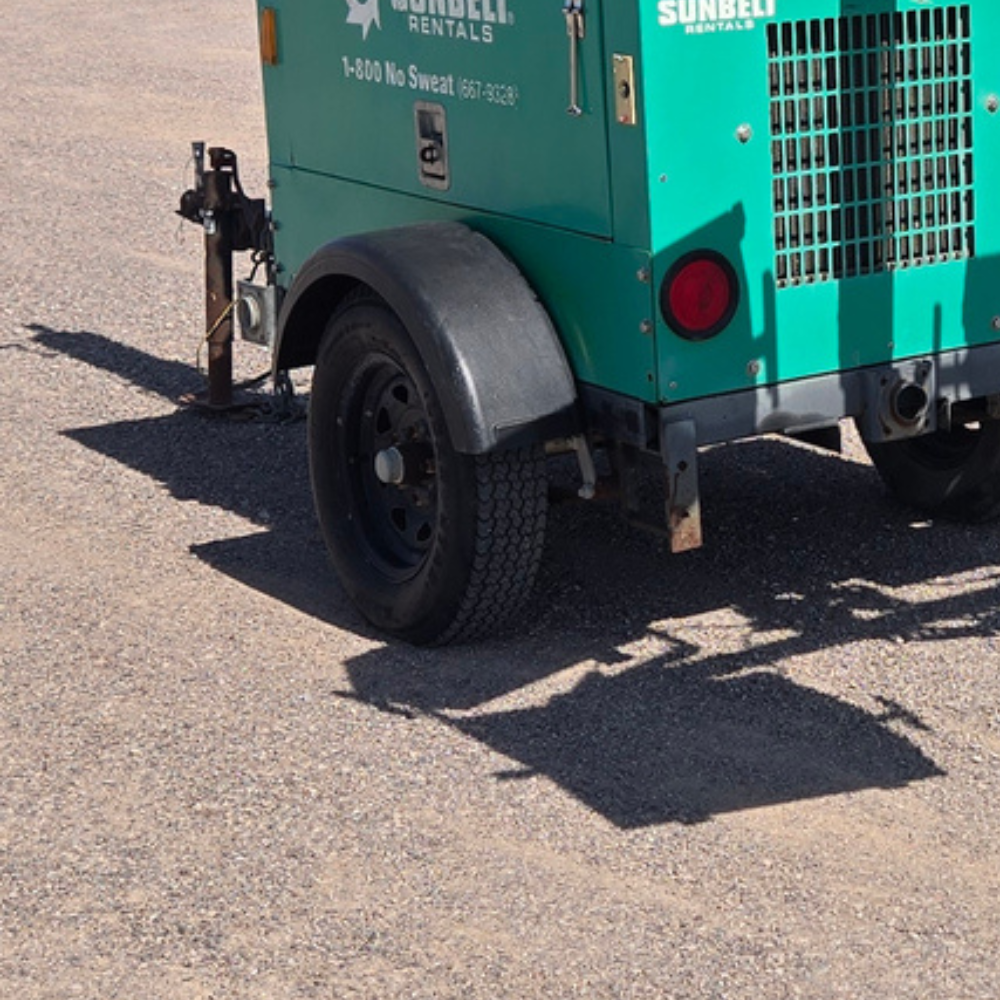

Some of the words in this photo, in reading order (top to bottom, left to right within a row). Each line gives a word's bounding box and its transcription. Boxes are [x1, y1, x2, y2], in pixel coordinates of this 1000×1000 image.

[408, 15, 493, 43] RENTALS
[685, 19, 755, 35] RENTALS
[341, 55, 382, 83] 1-800
[385, 60, 406, 88] No
[408, 64, 455, 96] Sweat
